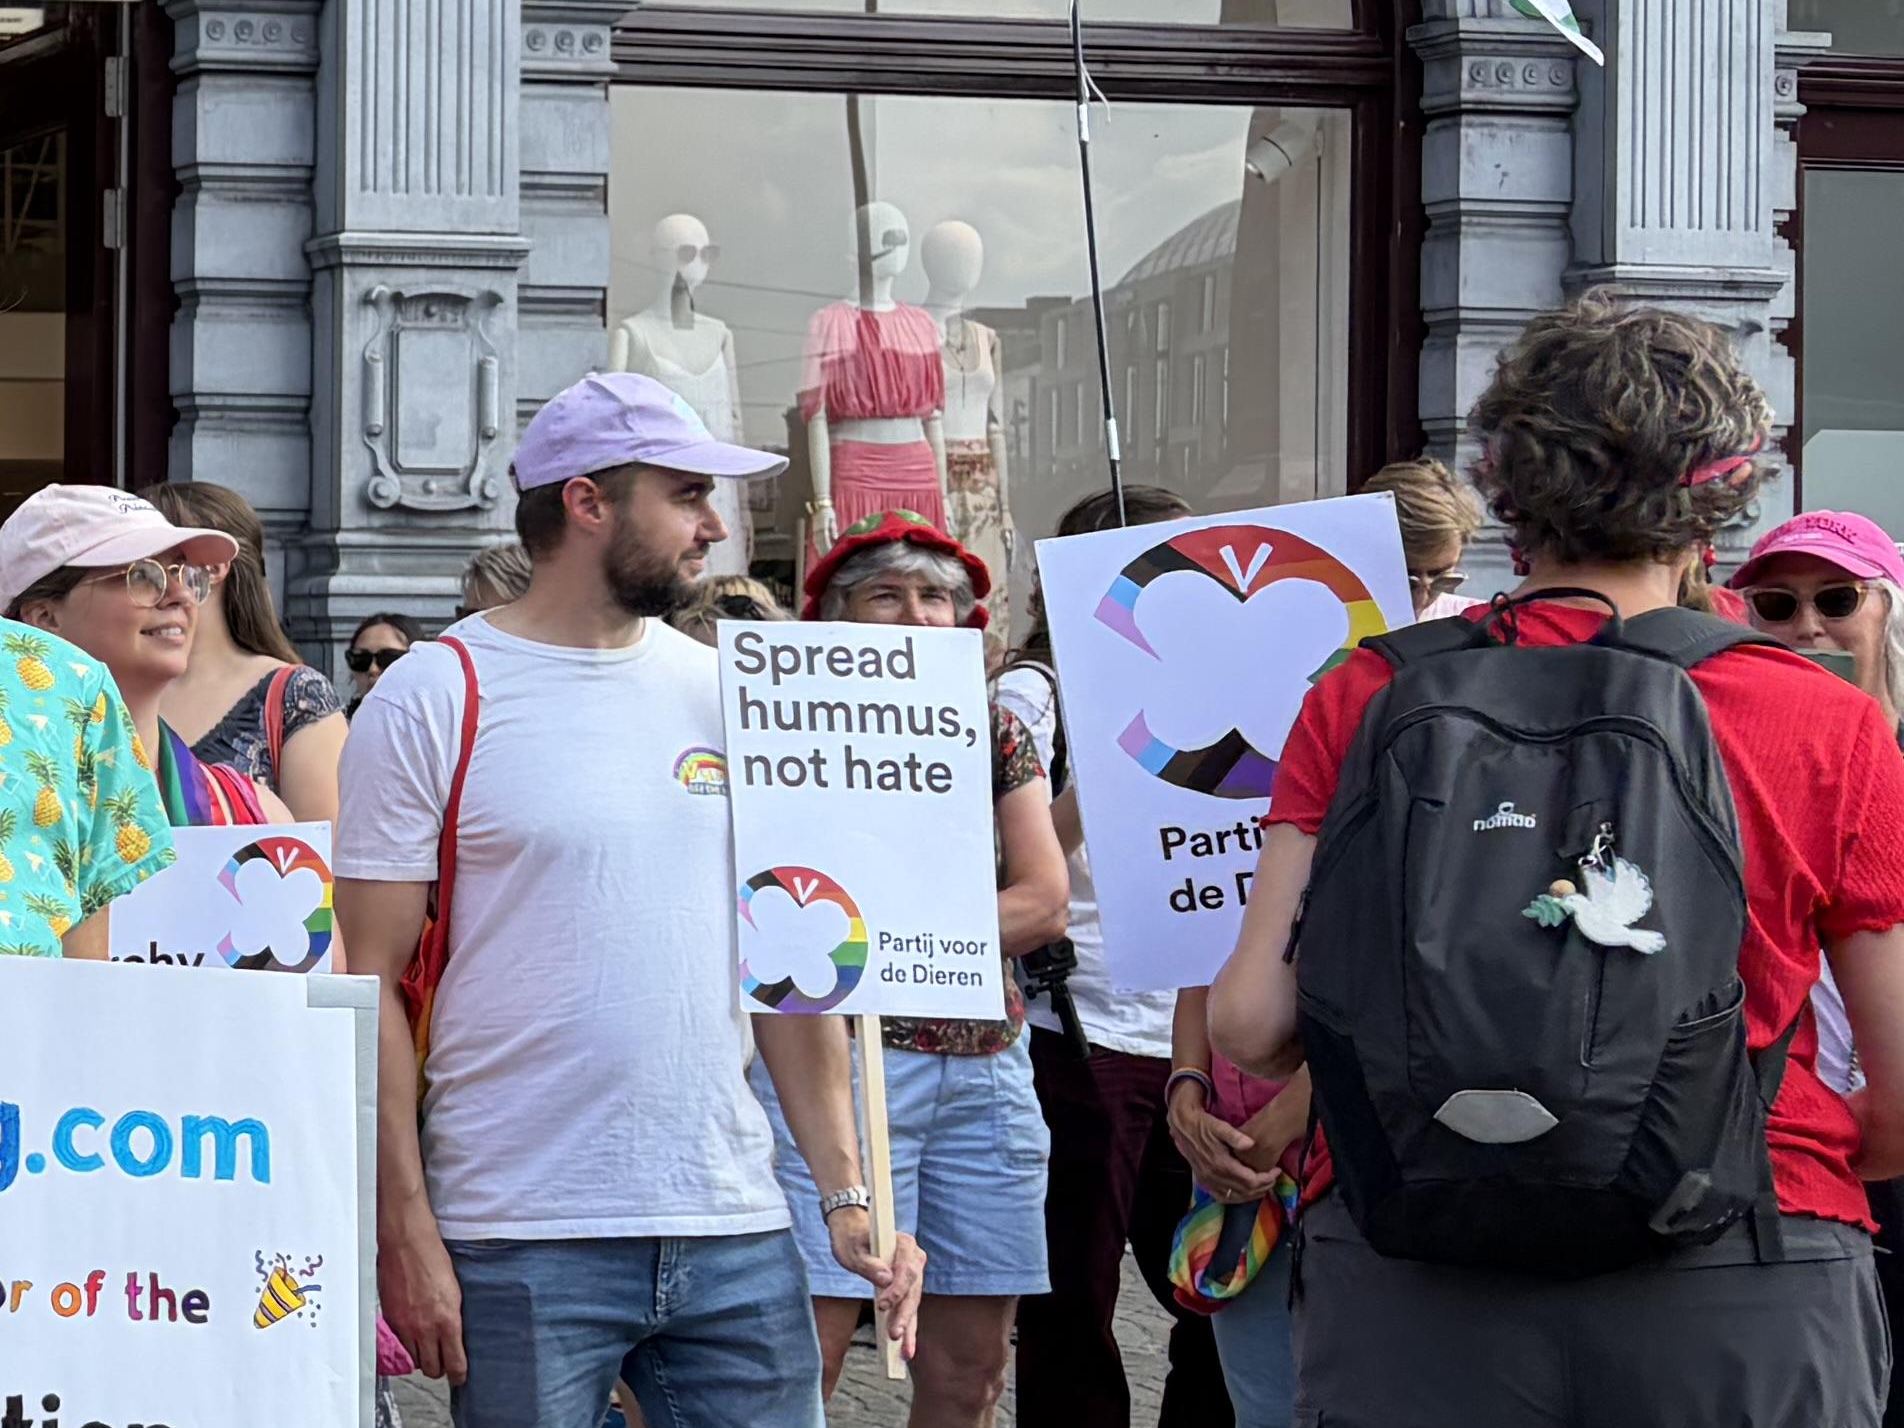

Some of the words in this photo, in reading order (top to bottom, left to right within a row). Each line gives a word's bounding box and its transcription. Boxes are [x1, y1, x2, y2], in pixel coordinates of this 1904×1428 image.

[735, 631, 915, 685] Spread
[739, 686, 976, 747] hummus,
[744, 749, 828, 788] not
[845, 745, 952, 793] hate
[1159, 815, 1262, 860] Parti
[1170, 878, 1224, 912] de
[879, 932, 933, 958] Partij
[940, 940, 987, 956] voor
[881, 962, 906, 983] de
[913, 964, 982, 986] Dieren
[50, 1270, 105, 1317] of
[125, 1271, 210, 1325] the
